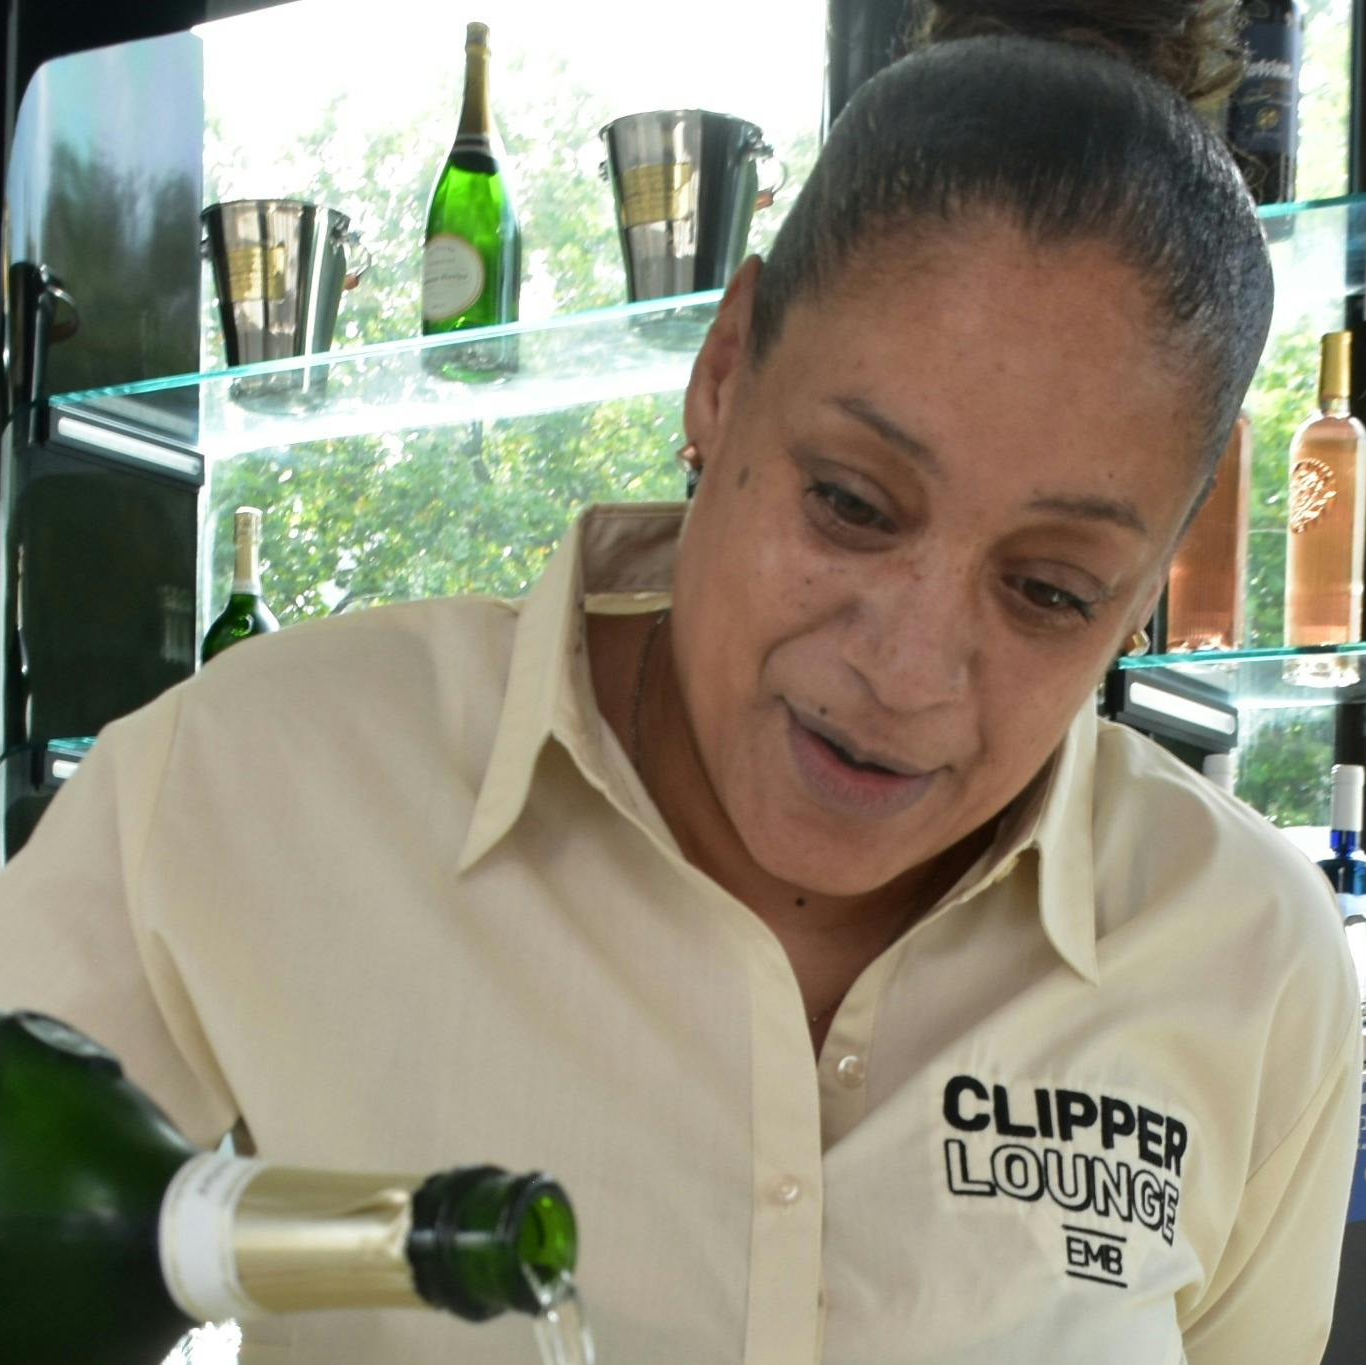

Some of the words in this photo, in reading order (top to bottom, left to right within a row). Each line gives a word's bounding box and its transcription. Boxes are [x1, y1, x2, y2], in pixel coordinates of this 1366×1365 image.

[943, 1075, 1187, 1177] CLIPPER
[944, 1138, 1180, 1246] LOUNGE
[1066, 1236, 1123, 1276] EMB
